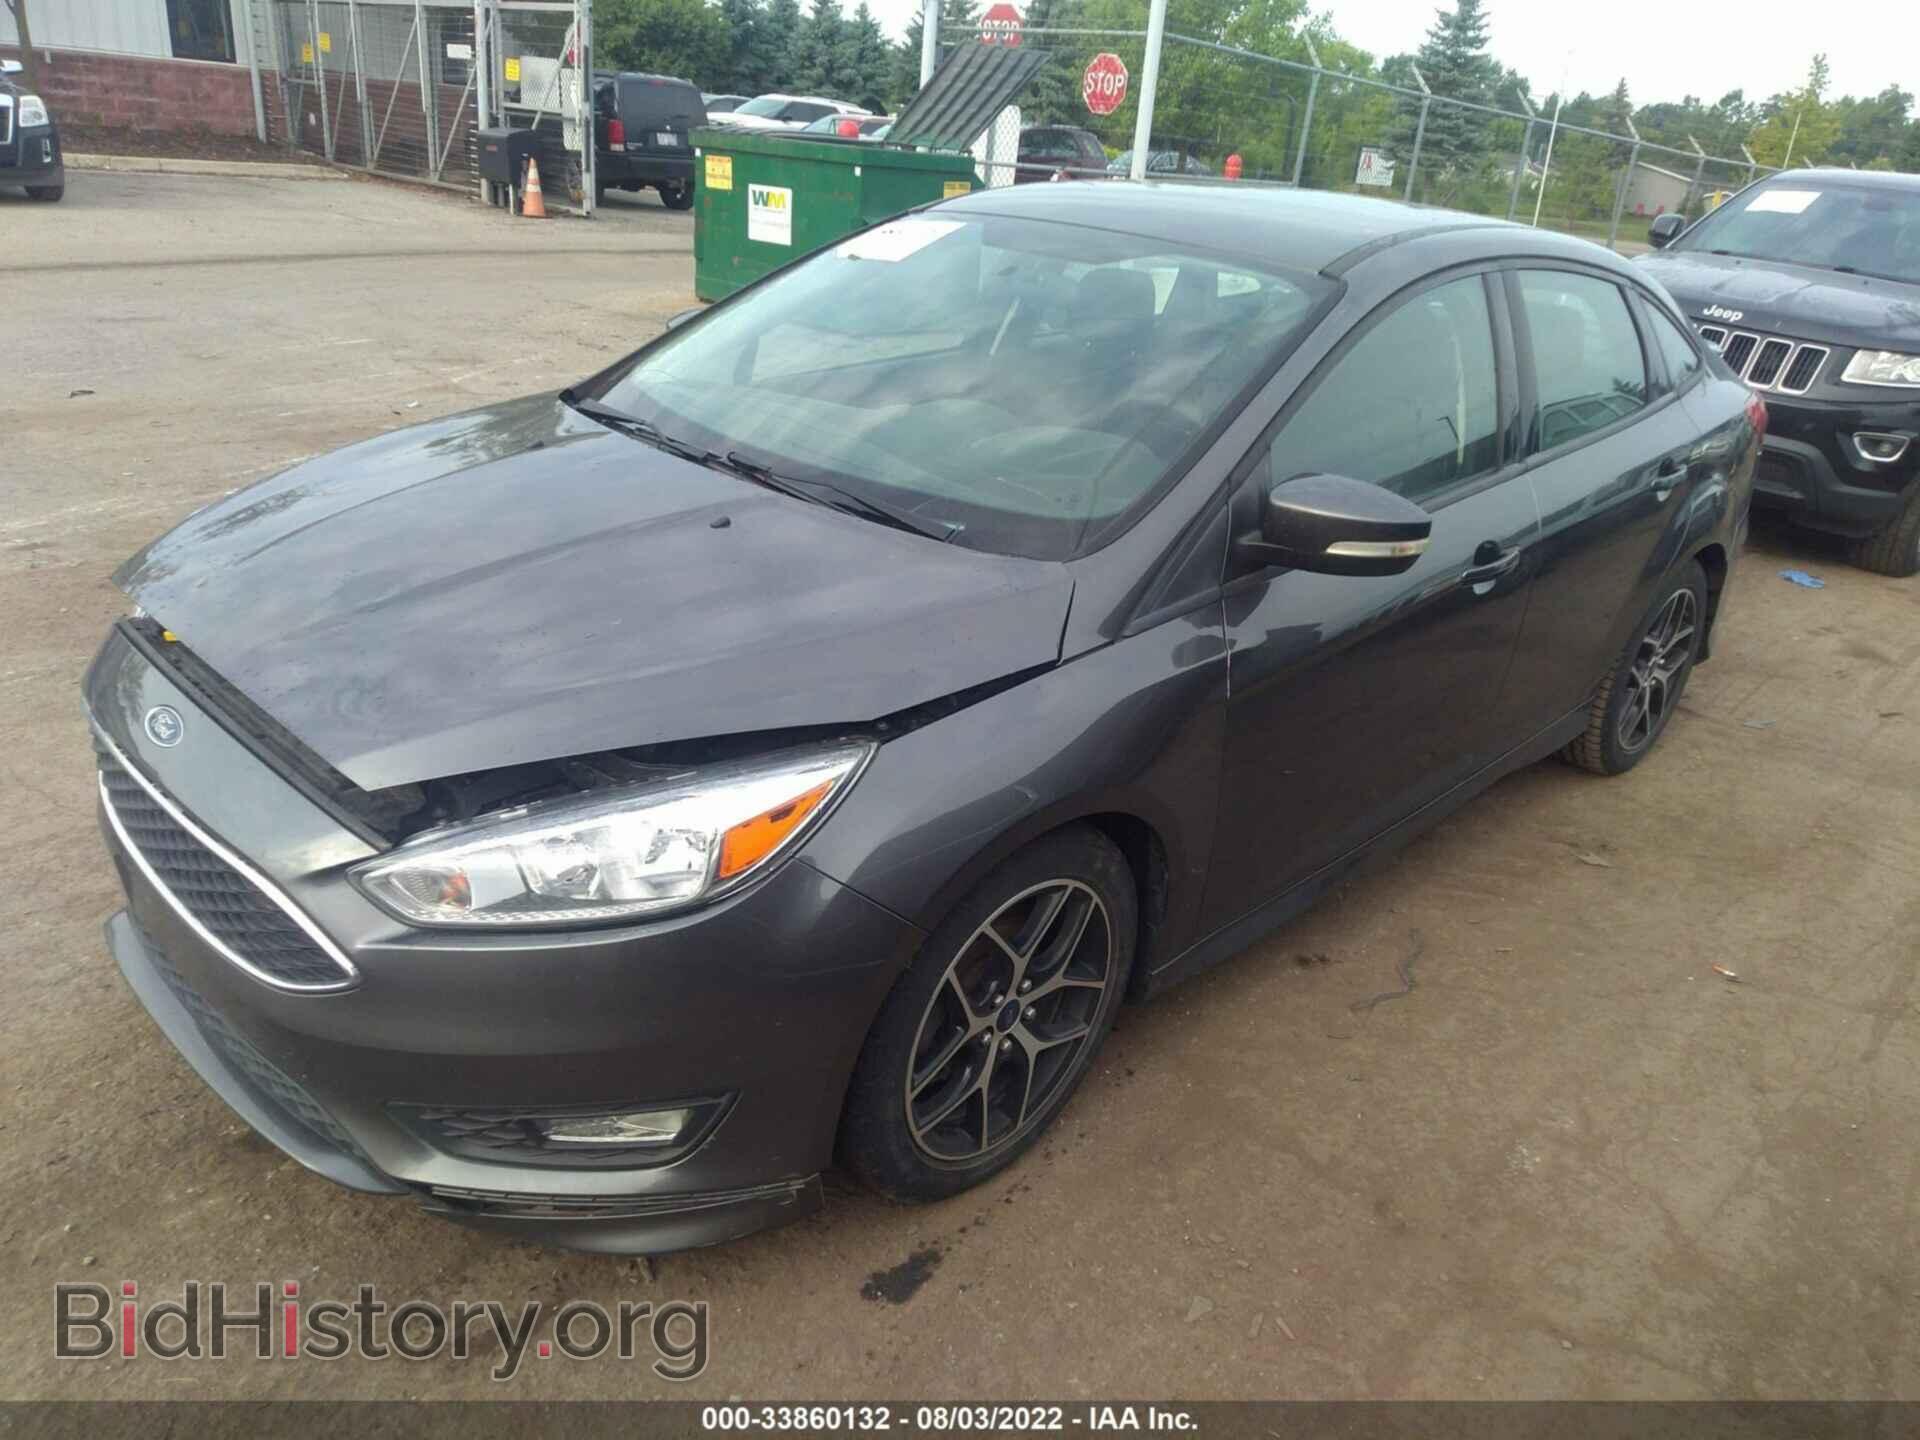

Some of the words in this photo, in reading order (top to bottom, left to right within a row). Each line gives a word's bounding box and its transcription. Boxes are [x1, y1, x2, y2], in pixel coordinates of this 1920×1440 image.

[1086, 71, 1125, 97] STOP
[751, 189, 787, 208] WM
[1703, 304, 1743, 322] Jeep
